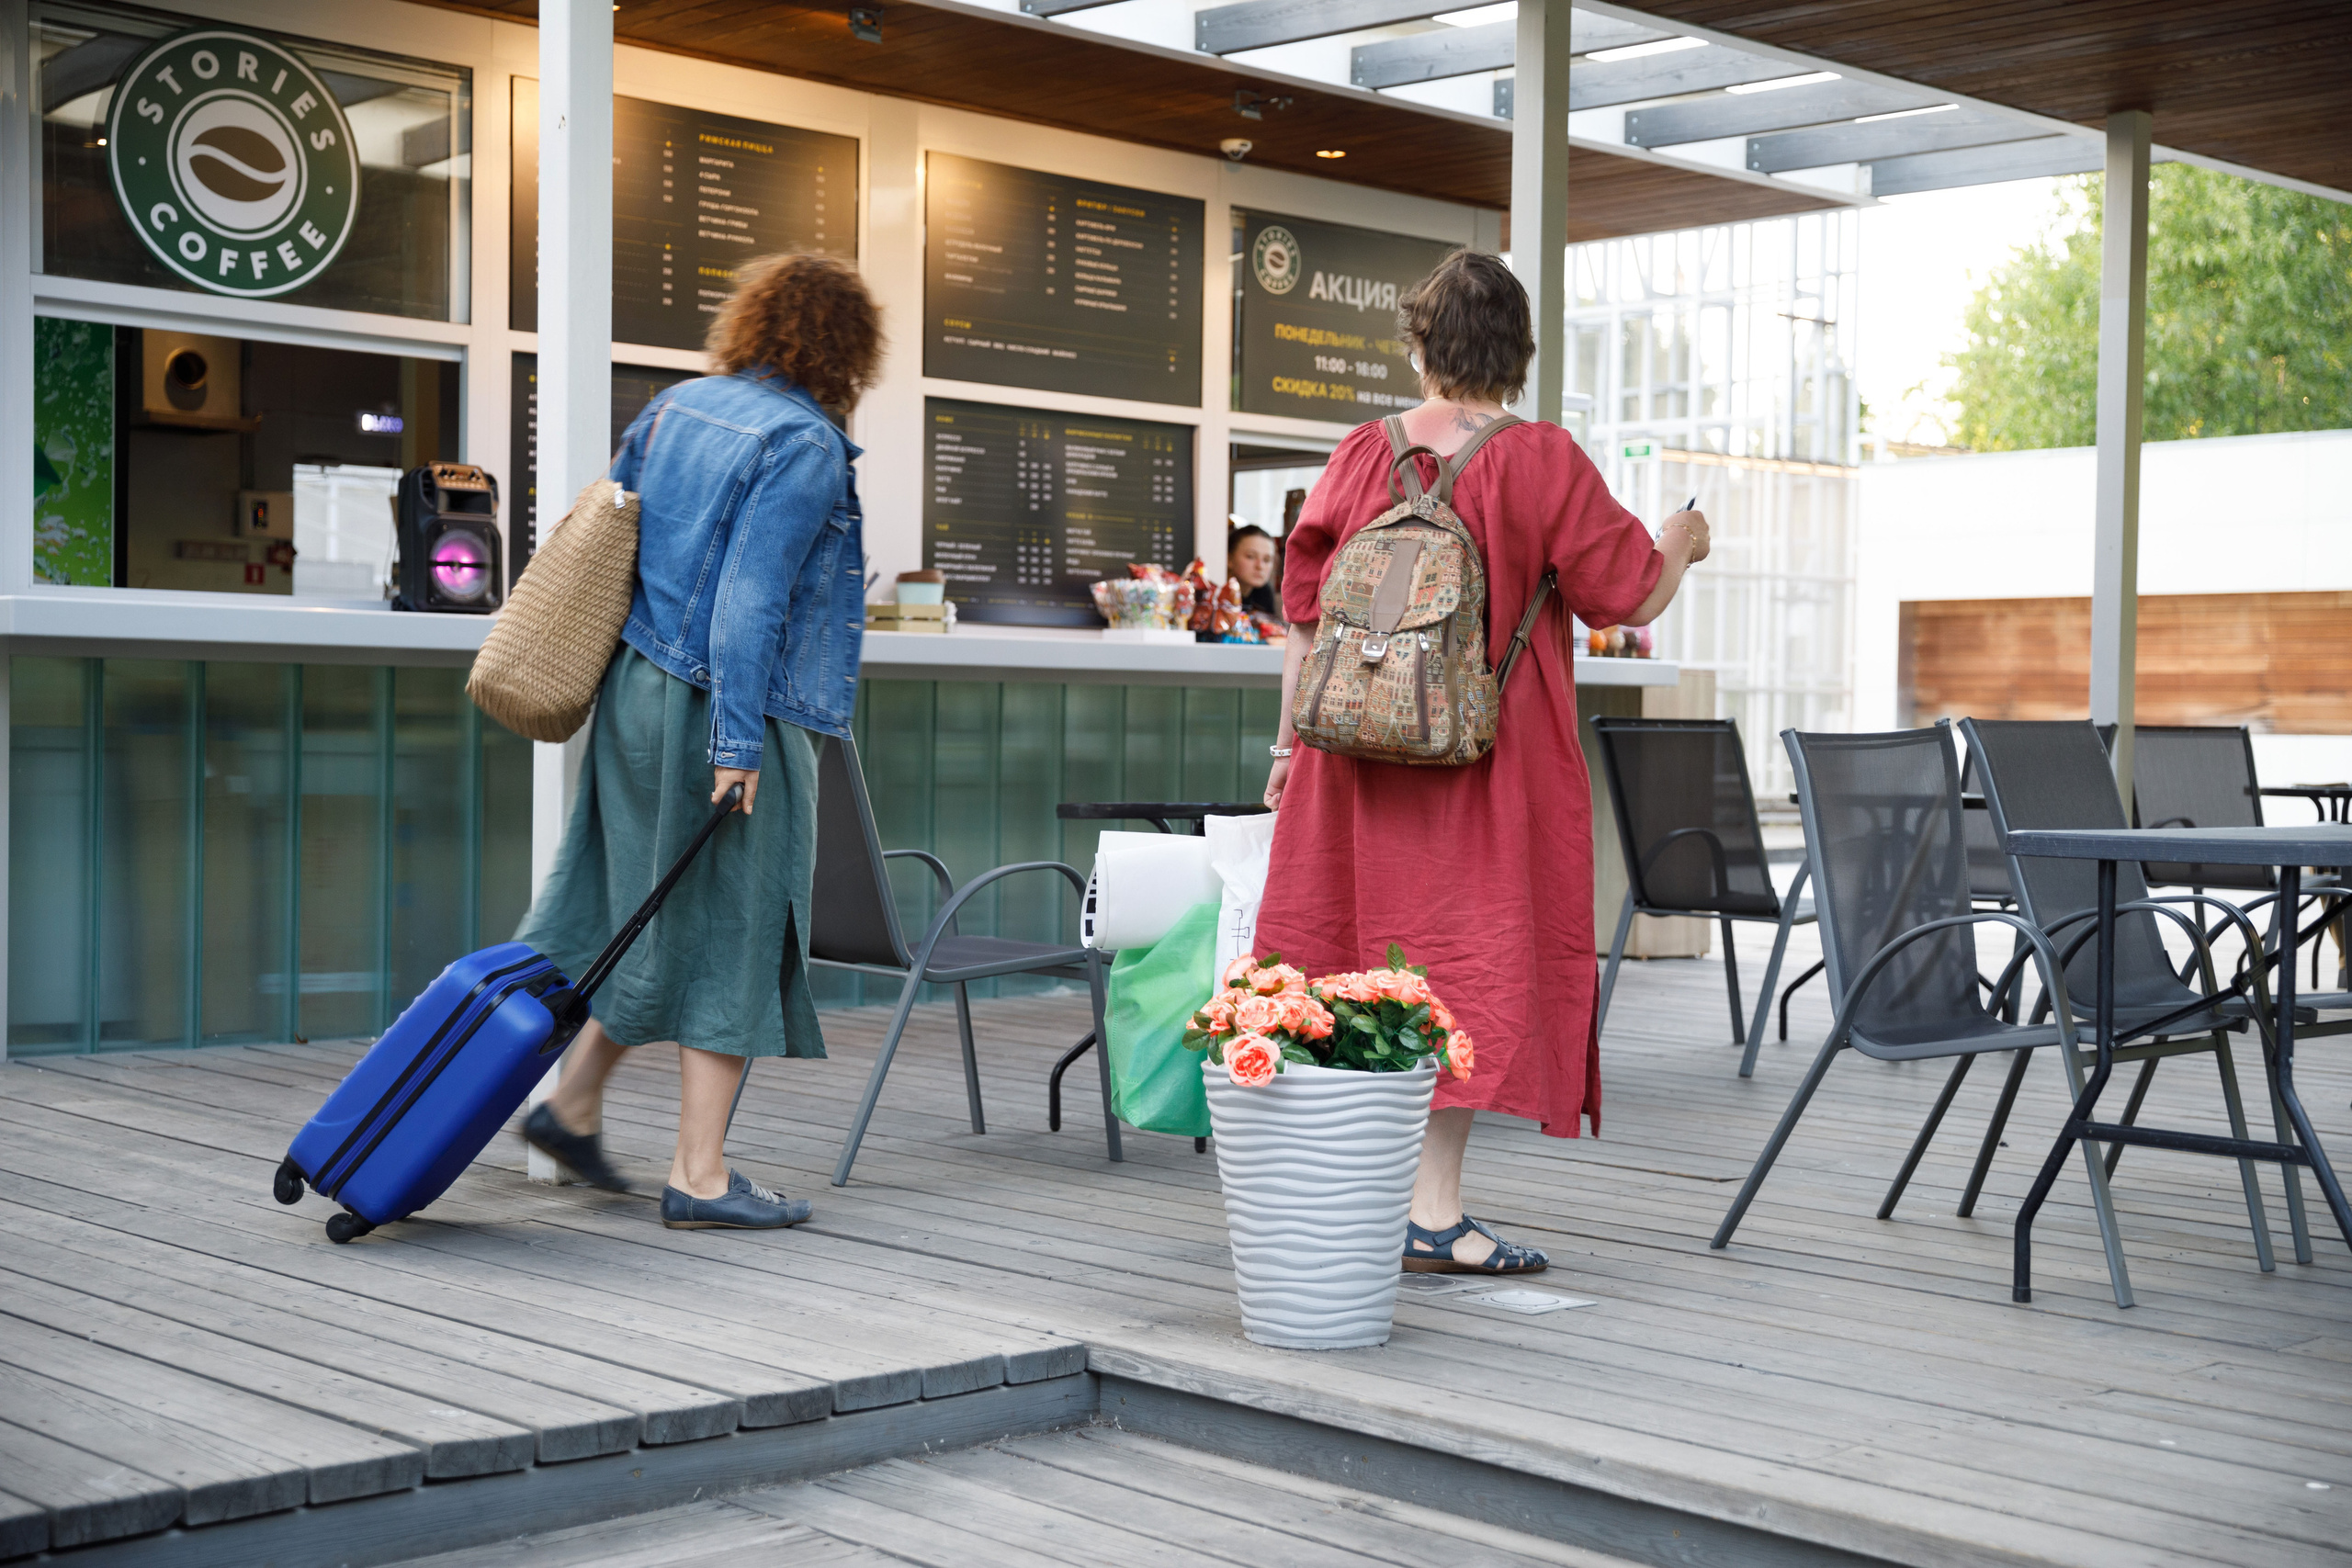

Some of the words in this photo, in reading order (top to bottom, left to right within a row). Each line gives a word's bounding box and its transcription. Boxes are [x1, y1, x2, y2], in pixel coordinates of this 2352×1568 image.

[137, 51, 335, 151] STORIES
[150, 202, 327, 279] COFFEE
[1308, 270, 1397, 312] АКЦИЯ
[1273, 322, 1366, 351] ПОНЕДЕЛЬНИК
[1314, 355, 1347, 375] 11:00
[1272, 376, 1328, 399] СКИДКА
[1329, 383, 1355, 402] 20%
[1356, 390, 1372, 404] на
